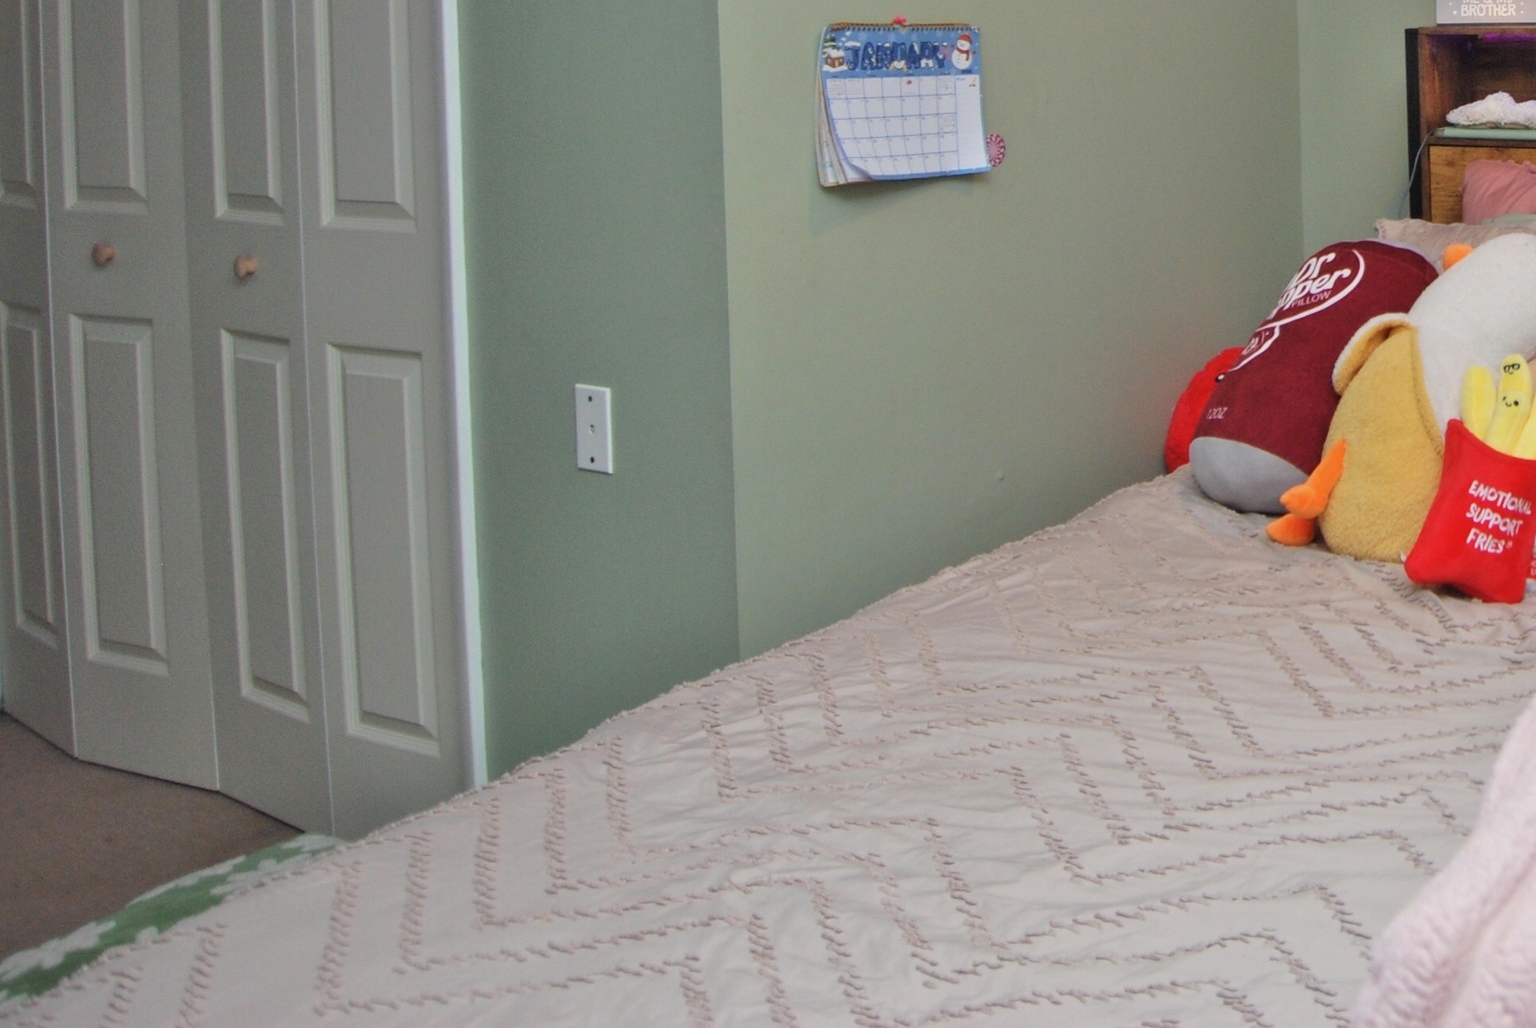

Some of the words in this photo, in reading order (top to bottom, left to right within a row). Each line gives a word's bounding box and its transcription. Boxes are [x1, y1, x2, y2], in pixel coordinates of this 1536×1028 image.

[1460, 4, 1516, 17] BROTHER
[844, 41, 948, 71] JANUARY
[1291, 290, 1331, 308] PILLOW
[1468, 479, 1532, 515] EMOTIONAL
[1465, 503, 1523, 537] SUPPORT
[1466, 527, 1505, 554] FRIES
